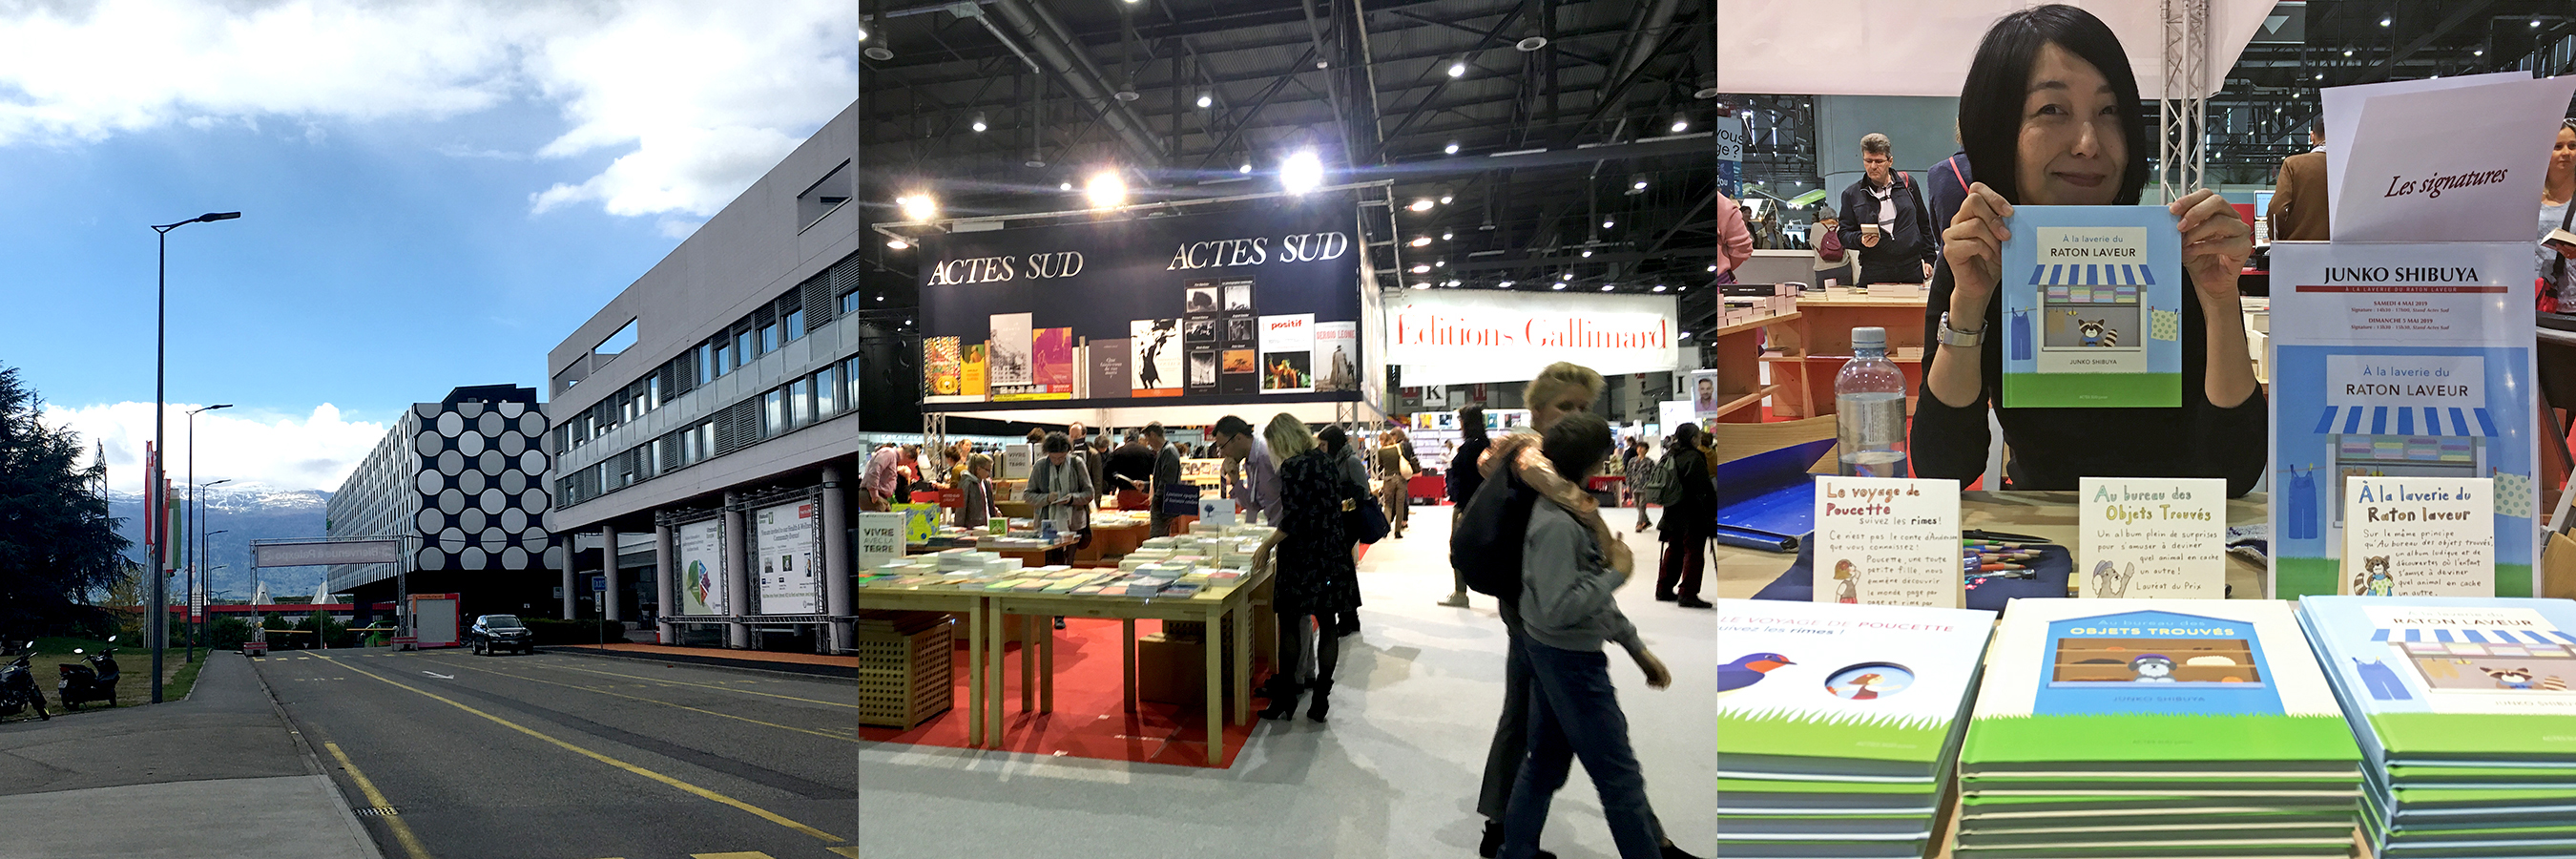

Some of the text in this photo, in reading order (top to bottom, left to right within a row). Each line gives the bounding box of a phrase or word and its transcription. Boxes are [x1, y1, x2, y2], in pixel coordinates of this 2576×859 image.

[2385, 168, 2508, 198] Les signatures
[2063, 233, 2069, 242] À
[1167, 232, 1348, 271] ACTES SUD
[2051, 248, 2136, 257] RATON LAVEUR
[927, 251, 1084, 286] ACTES SUD
[2324, 267, 2478, 284] JUNKO SHIBUYA
[1271, 319, 1302, 330] positif
[1396, 304, 1667, 349] Éditions Gallimard
[1317, 330, 1355, 339] SERGIO LEONE
[2363, 365, 2450, 377] À la laverie du
[1426, 385, 1444, 400] K
[2347, 384, 2468, 397] RATON LAVEUR
[1827, 483, 1920, 503] Le voyage de
[2094, 485, 2192, 502] Au bureau des
[2359, 480, 2471, 503] À la laverie du
[1826, 503, 1891, 516] Poucette
[2106, 504, 2211, 525] Objets Trouvés
[2368, 507, 2471, 522] Raton laveur
[864, 528, 894, 536] VIVRE
[1830, 530, 1841, 540] Ce
[1845, 531, 1865, 540] n'est
[1870, 534, 1884, 543] pas
[2115, 529, 2142, 537] album
[2147, 528, 2166, 540] plein
[2182, 532, 2218, 541] surprises
[2421, 530, 2454, 539] principe
[2098, 544, 2114, 552] pour
[2438, 539, 2461, 548] objets
[2140, 554, 2154, 563] quel
[2432, 550, 2458, 558] ludique
[1868, 567, 1893, 575] petite
[1907, 589, 1923, 599] page
[1927, 590, 1937, 598] par
[1748, 617, 1817, 626] VOYAGE
[1859, 622, 1954, 633] POUCETTE
[2070, 627, 2235, 636] OBJETS TROUVÉS
